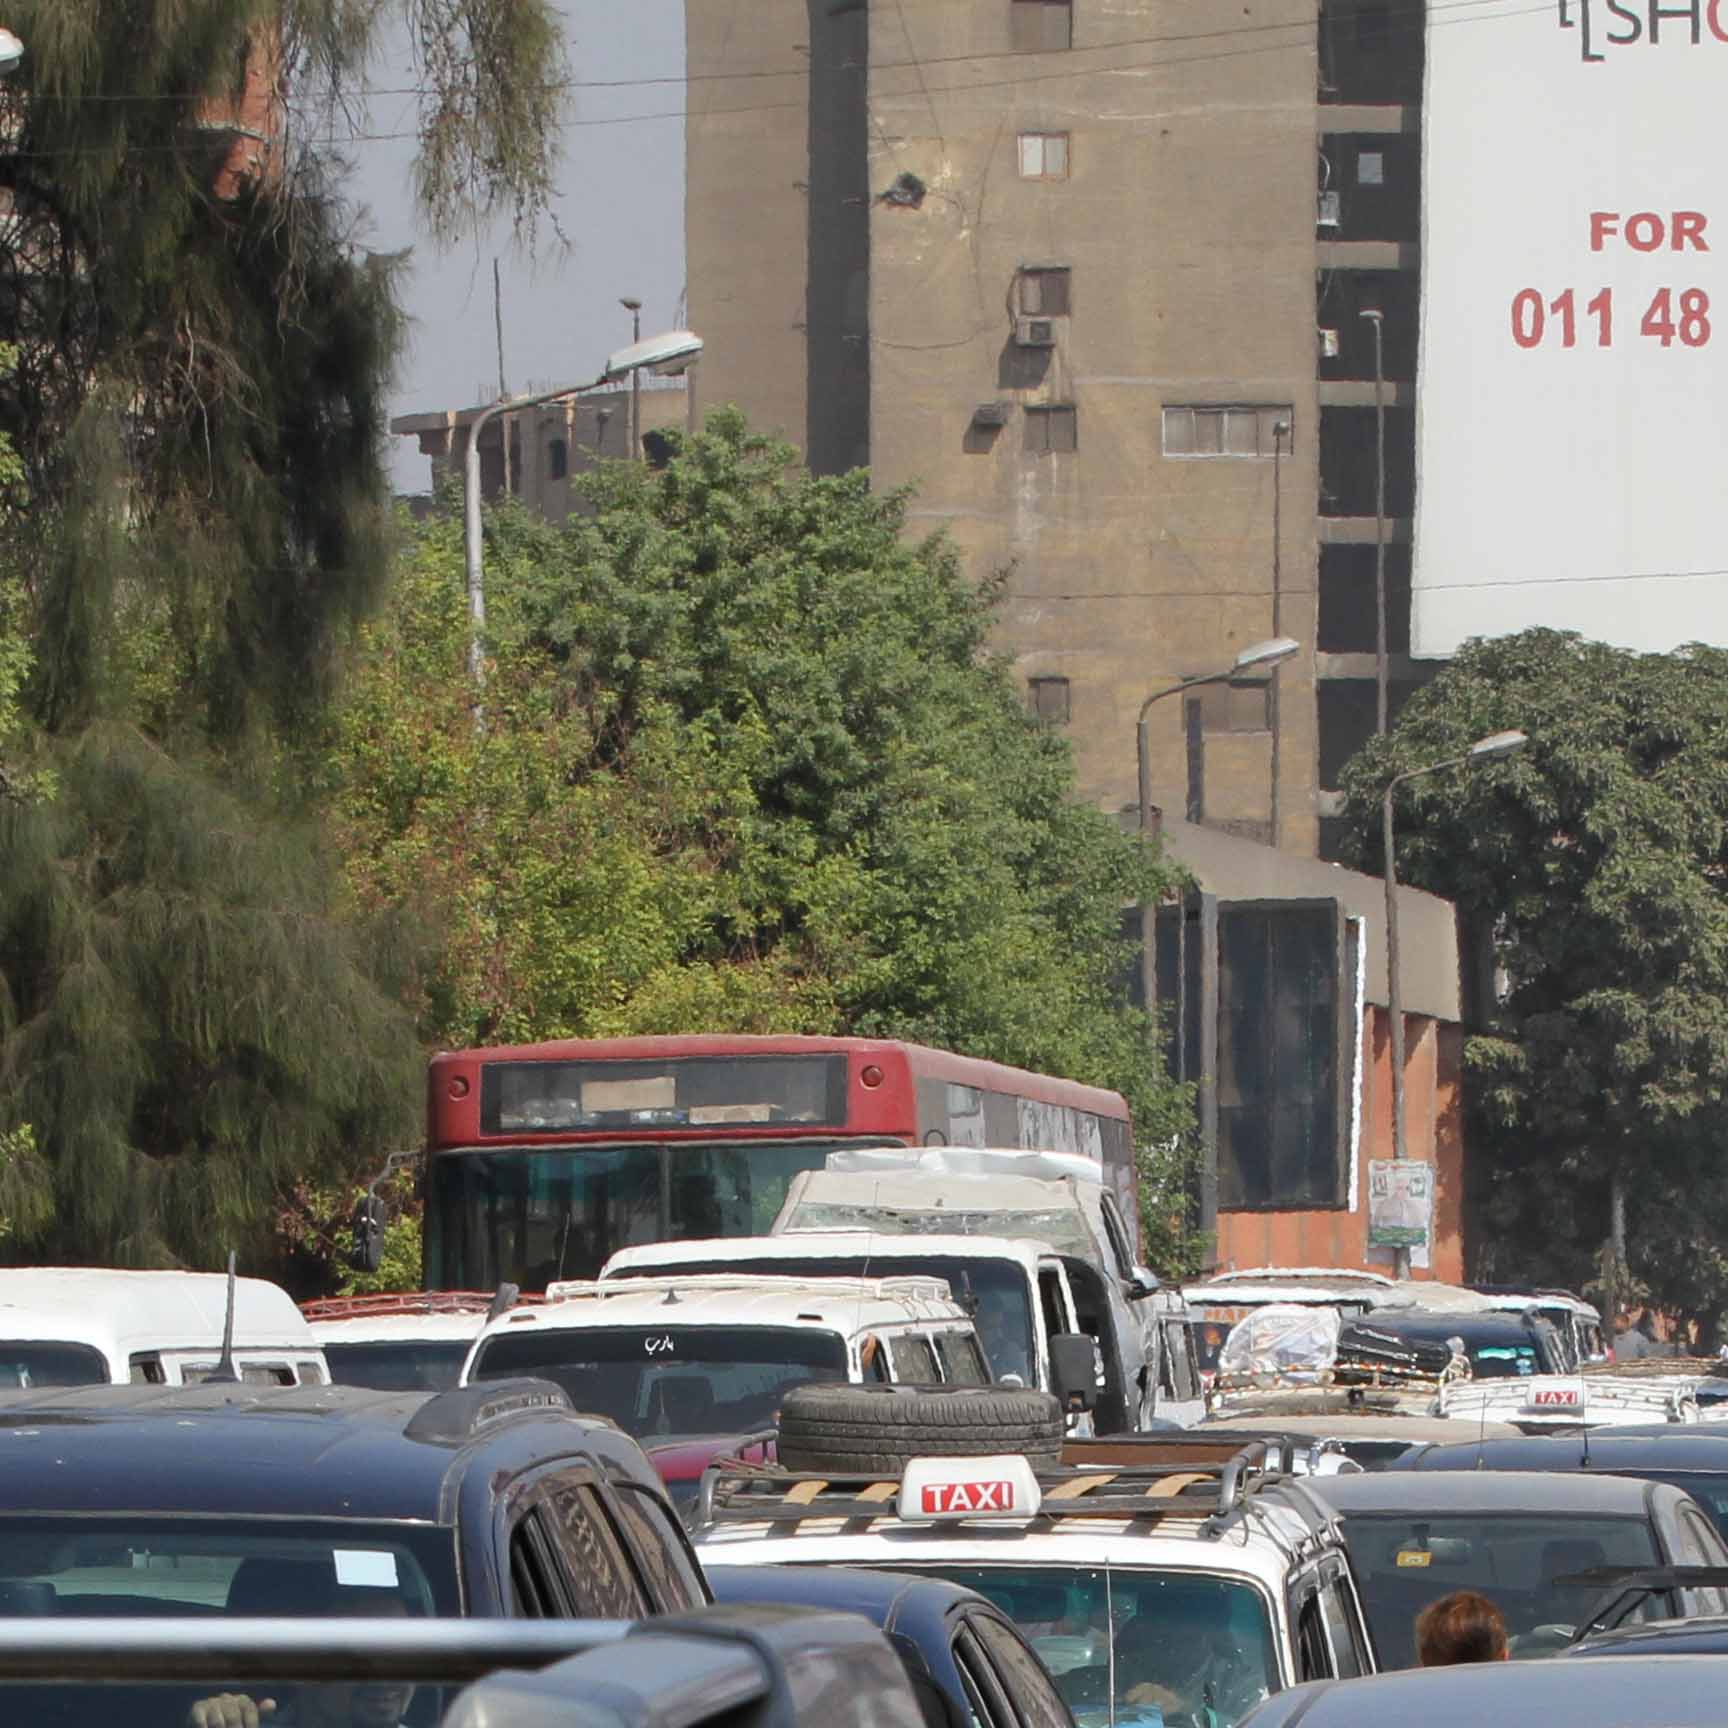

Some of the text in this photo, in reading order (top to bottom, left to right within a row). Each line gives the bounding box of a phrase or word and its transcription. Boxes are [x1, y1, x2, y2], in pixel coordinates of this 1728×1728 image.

[1590, 211, 1710, 253] FOR
[1511, 287, 1612, 349] 011
[1640, 287, 1712, 348] 48
[1536, 1391, 1576, 1405] TAXI
[925, 1481, 1010, 1511] TAXI
